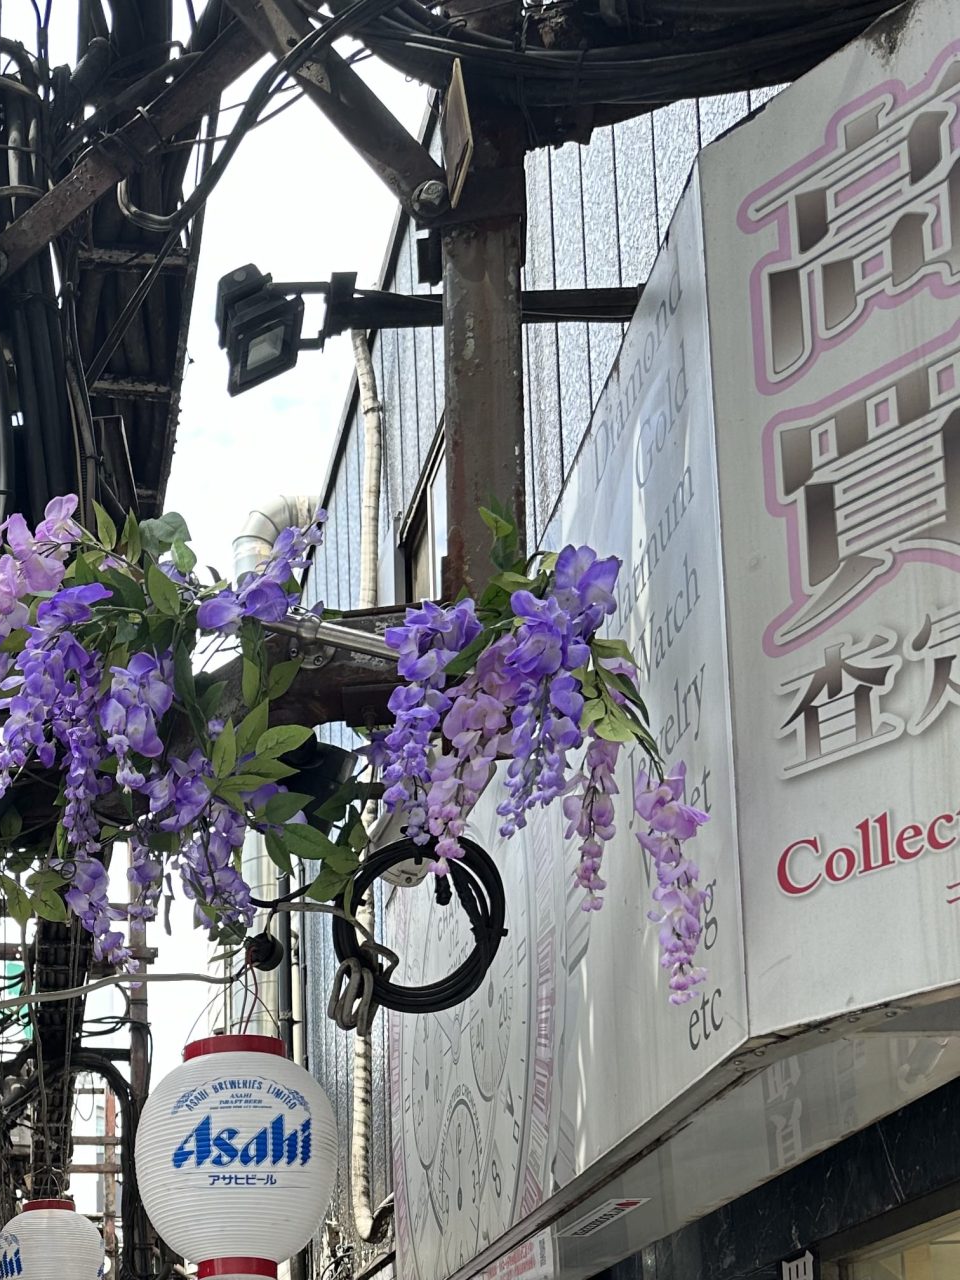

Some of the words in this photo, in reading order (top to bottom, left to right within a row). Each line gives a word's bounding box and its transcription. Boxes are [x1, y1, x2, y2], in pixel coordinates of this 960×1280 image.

[592, 266, 684, 491] Diamond
[635, 336, 690, 488] Gold
[688, 988, 723, 1051] etc
[185, 1089, 209, 1112] ASAHI
[211, 1079, 264, 1094] BREWERIES
[266, 1084, 299, 1110] LIMITED
[171, 1113, 312, 1169] Asahi
[208, 1174, 278, 1186] アサヒビール
